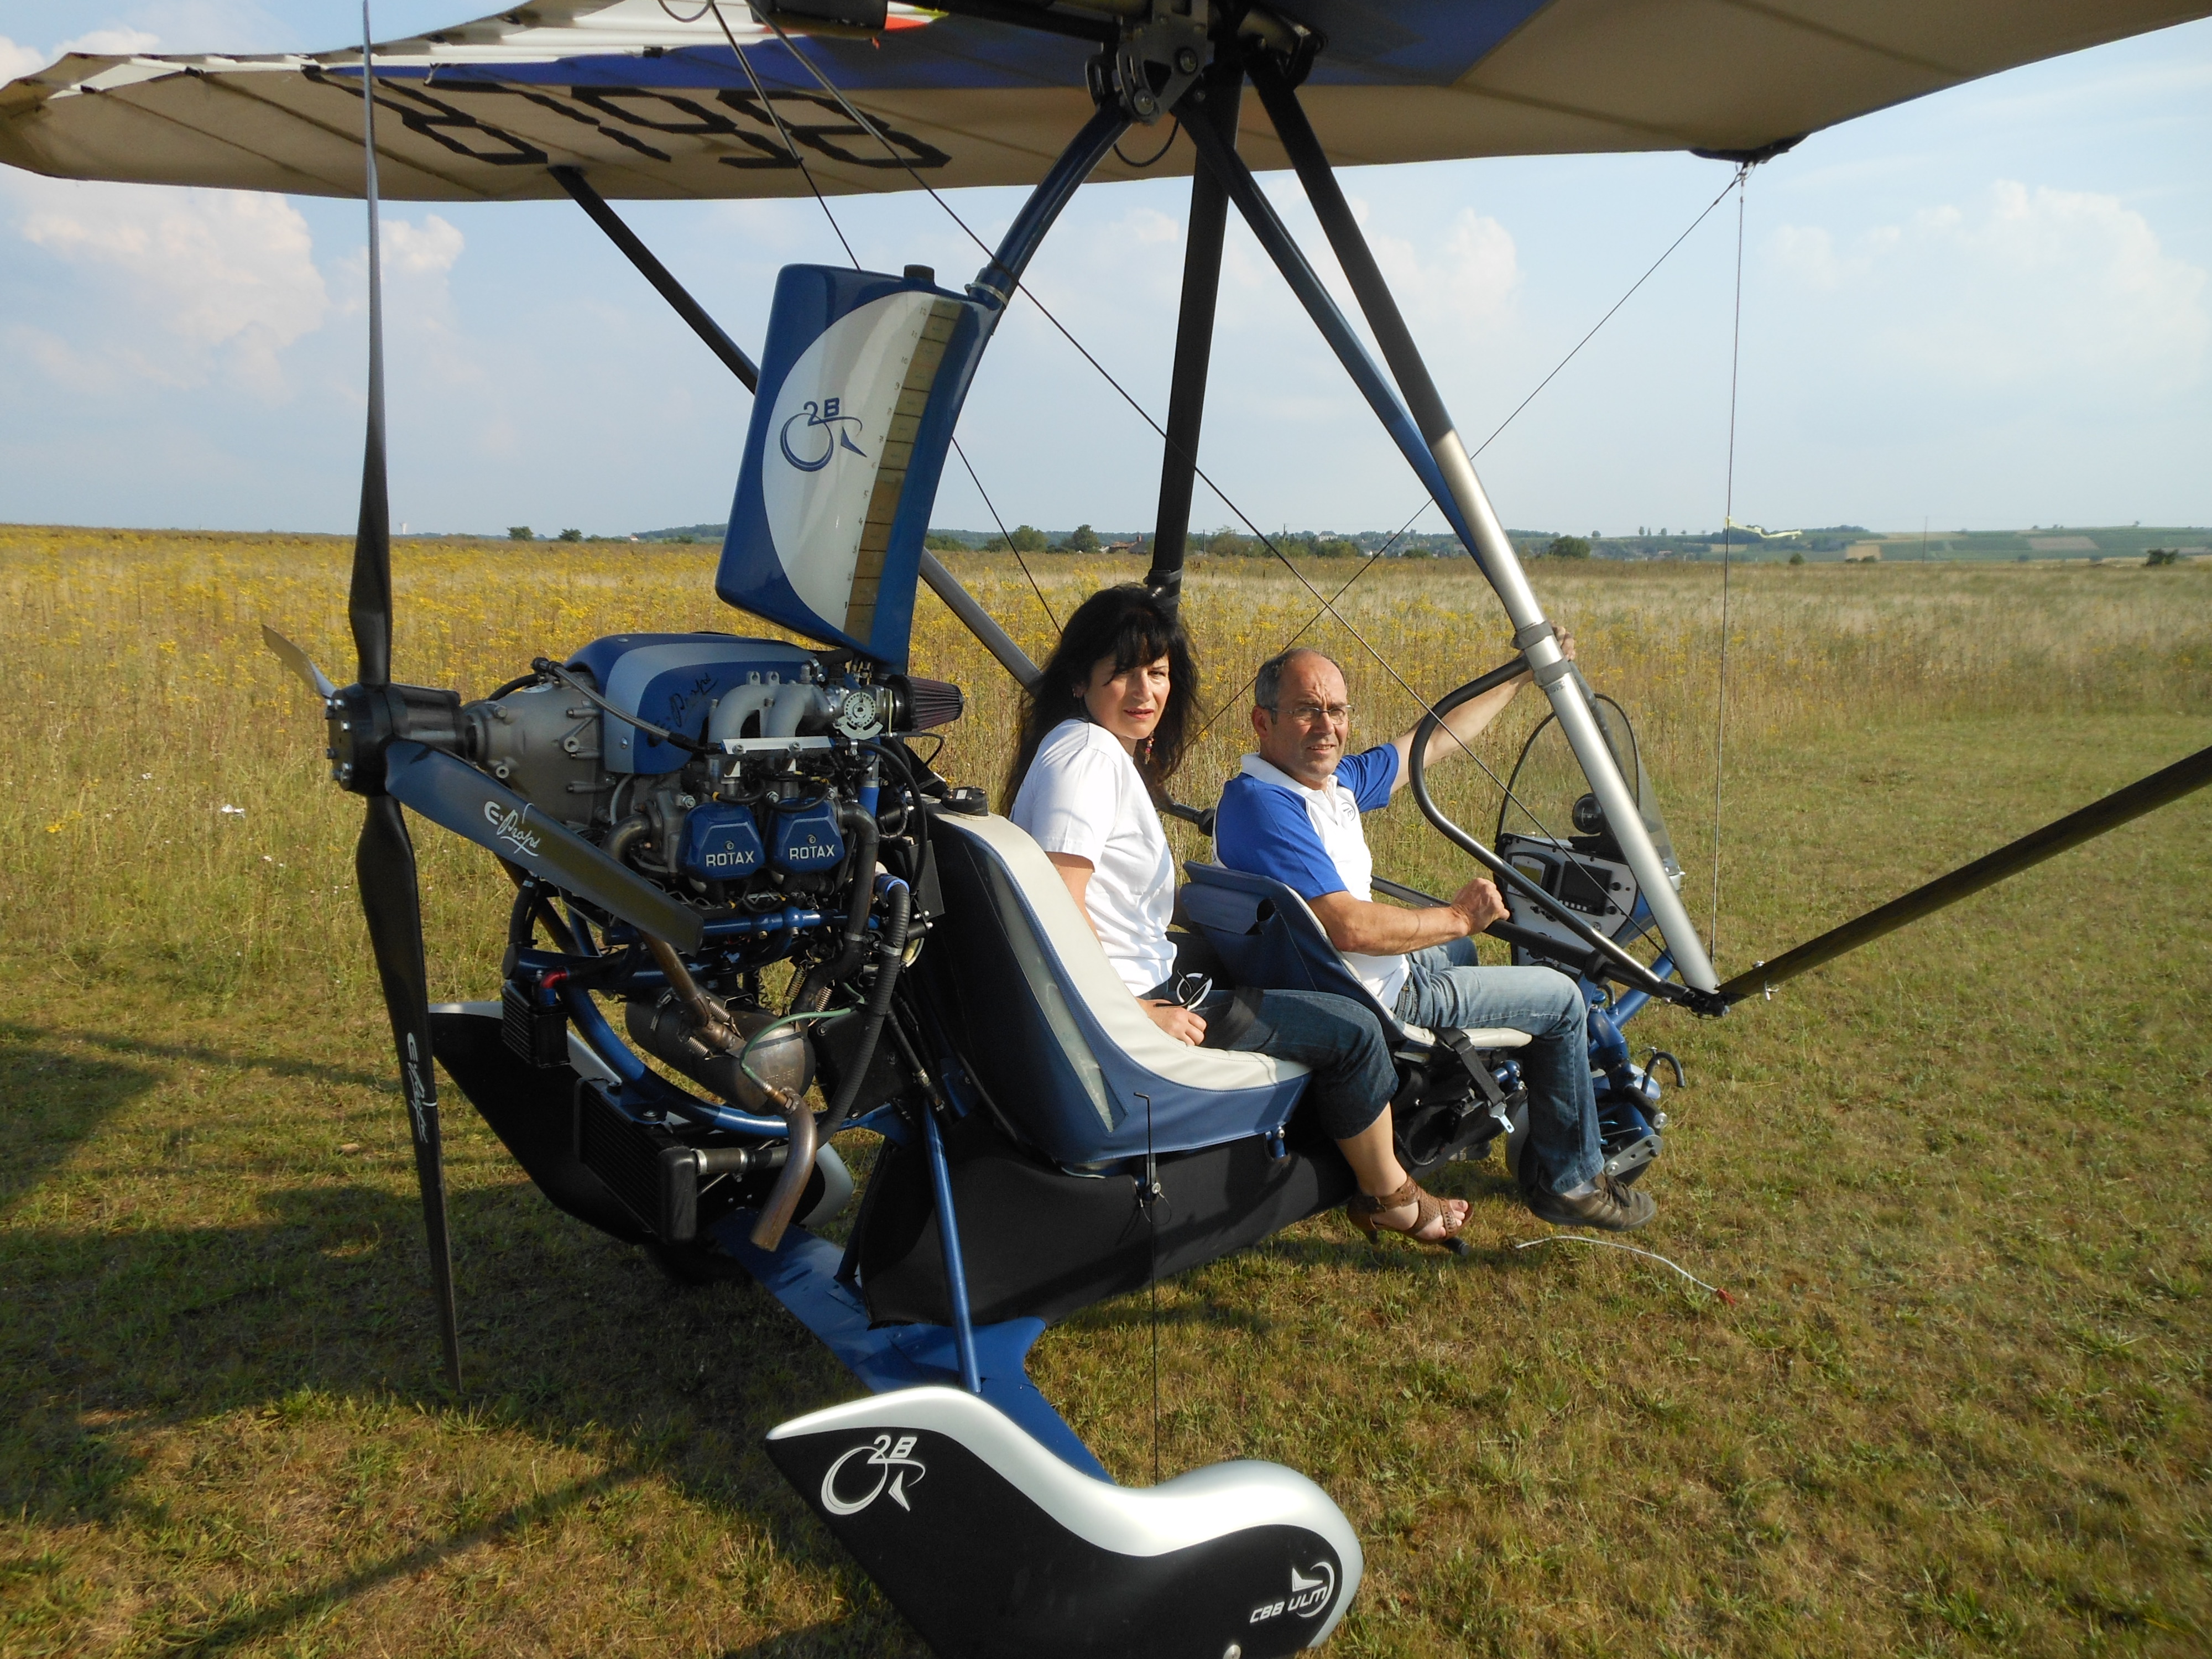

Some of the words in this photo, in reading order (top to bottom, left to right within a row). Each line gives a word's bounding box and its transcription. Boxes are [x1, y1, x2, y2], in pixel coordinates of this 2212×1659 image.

[706, 851, 754, 867] ROTAX
[790, 844, 835, 860] ROTAX
[1249, 1601, 1285, 1623] CBB
[1287, 1586, 1328, 1611] ULM
